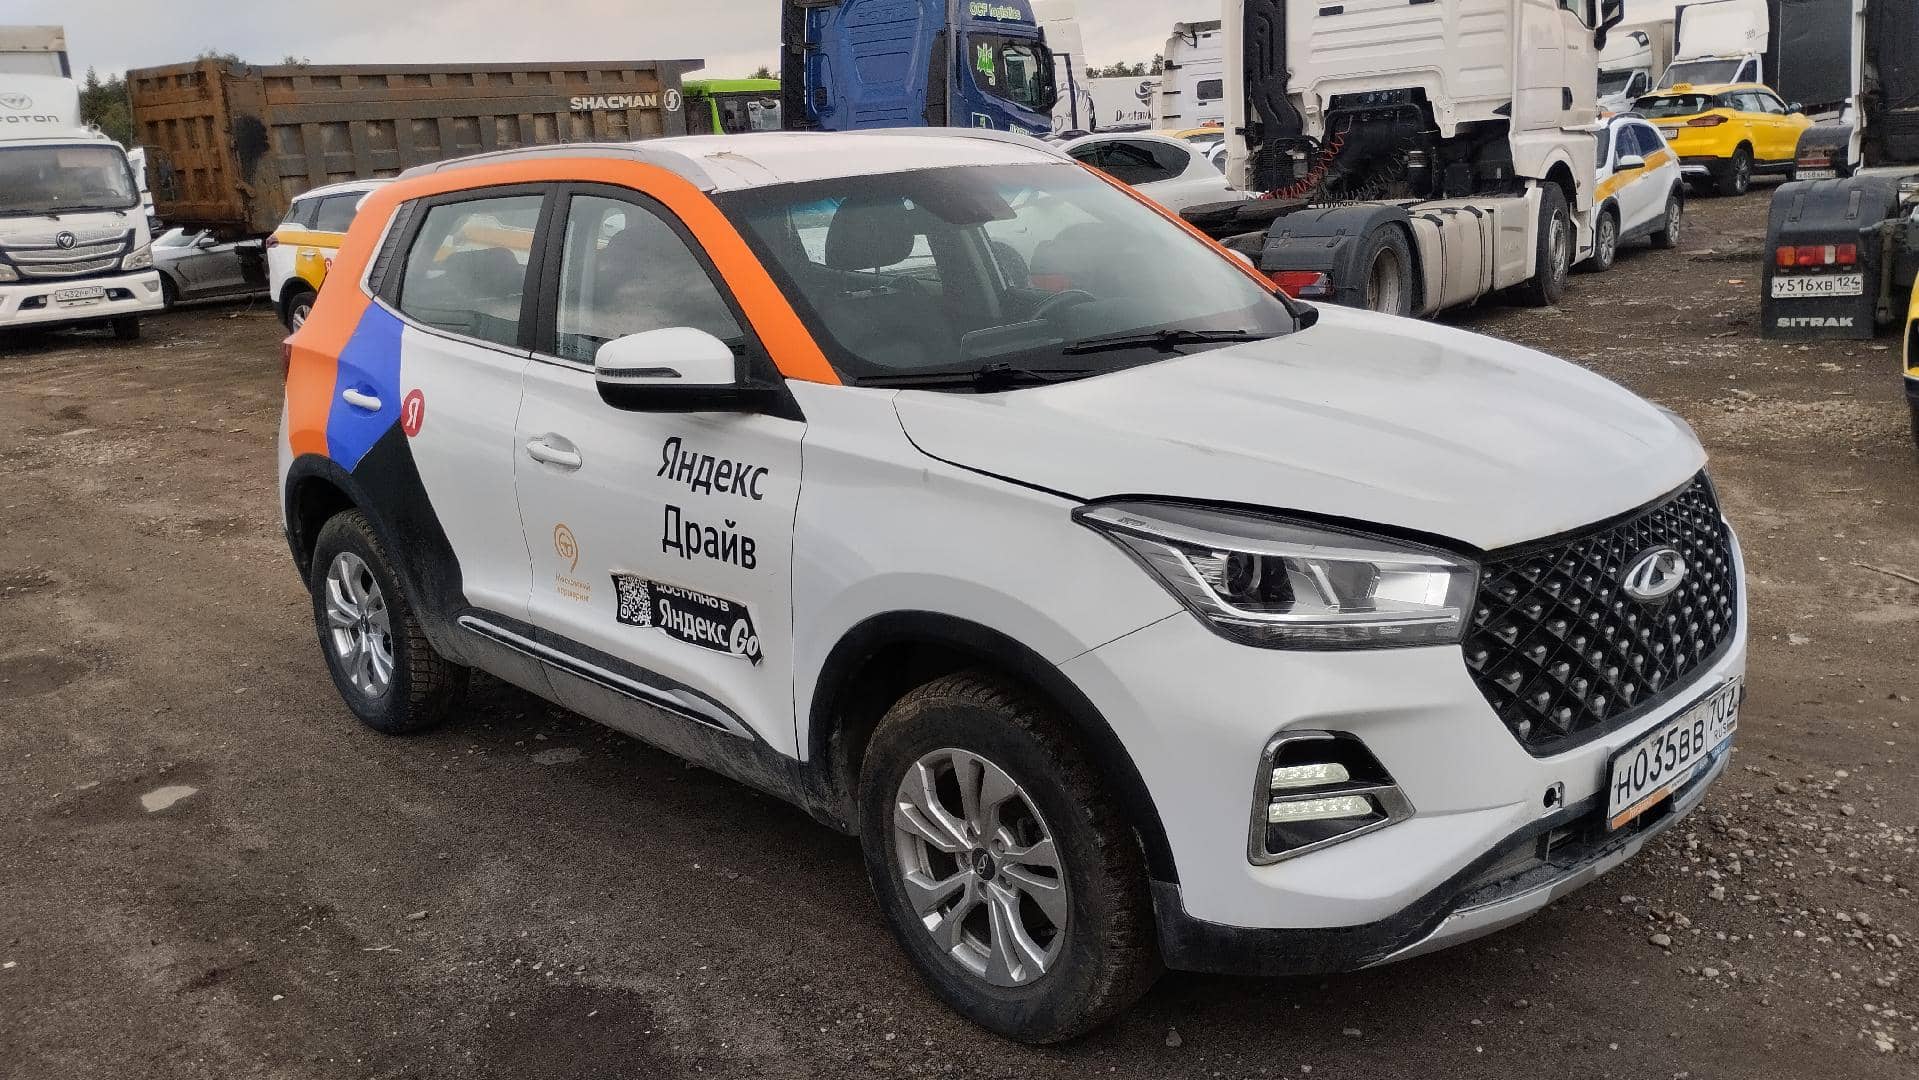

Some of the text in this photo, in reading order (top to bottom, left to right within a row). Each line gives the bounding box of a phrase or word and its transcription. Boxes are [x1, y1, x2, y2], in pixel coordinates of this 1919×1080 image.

[570, 94, 657, 109] SHACMAN
[0, 115, 59, 123] OTON
[1778, 277, 1860, 292] У516ХВ 124
[1777, 317, 1854, 328] SITRAK
[406, 397, 419, 429] Я
[657, 436, 769, 501] Яндекс
[662, 504, 757, 570] Драйв
[659, 599, 759, 656] Яндекс Go
[1617, 686, 1736, 804] Н035ВВ 702
[1714, 722, 1728, 742] RUS
